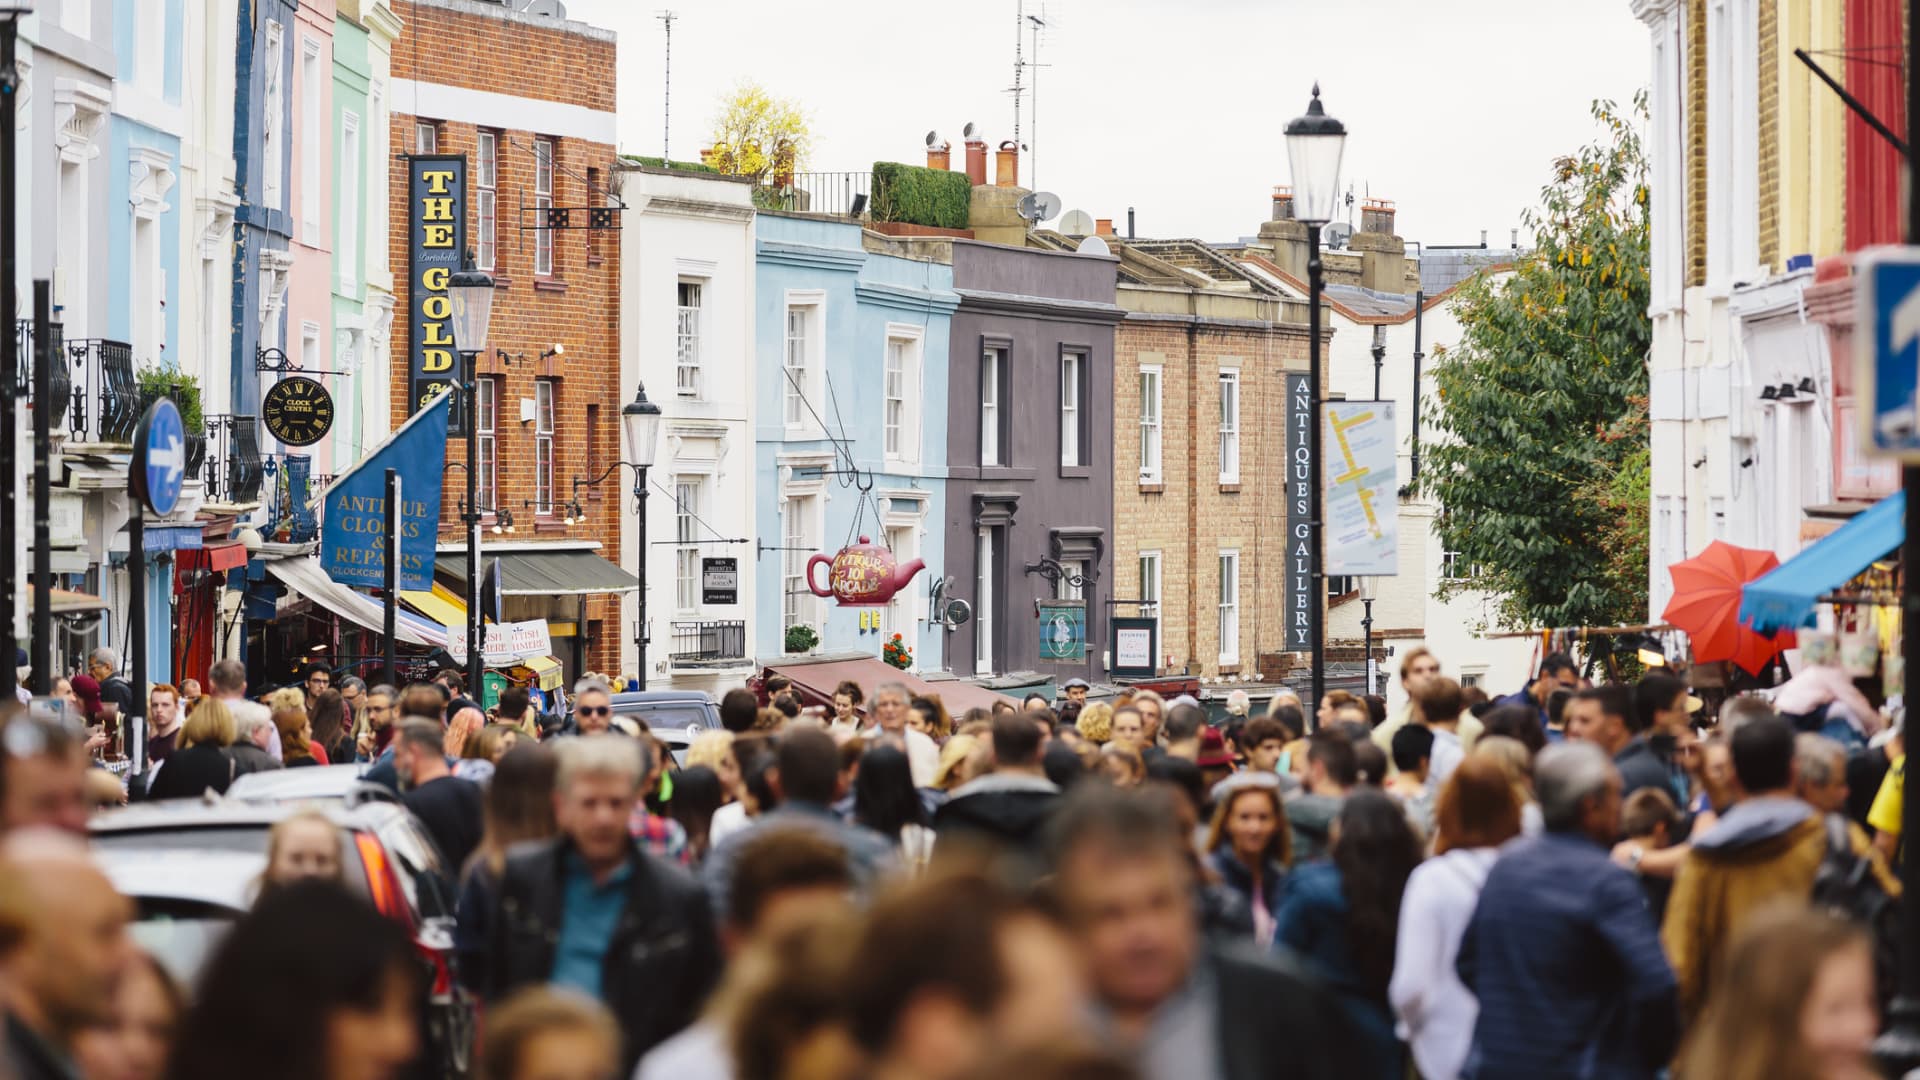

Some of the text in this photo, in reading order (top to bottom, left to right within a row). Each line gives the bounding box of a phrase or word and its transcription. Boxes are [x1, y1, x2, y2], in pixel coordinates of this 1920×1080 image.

[422, 171, 453, 247] THE
[422, 267, 453, 372] GOLD
[283, 405, 313, 413] CENTRE
[337, 495, 428, 518] ANTIUE
[1295, 378, 1310, 643] ANTIQUES GALLERY
[341, 516, 420, 538] CLOKS
[336, 547, 423, 569] REPARS
[332, 566, 422, 581] CLOCKCENCOM
[832, 576, 879, 594] ARCADE
[512, 630, 539, 640] TTISH
[454, 643, 506, 654] CAMERE
